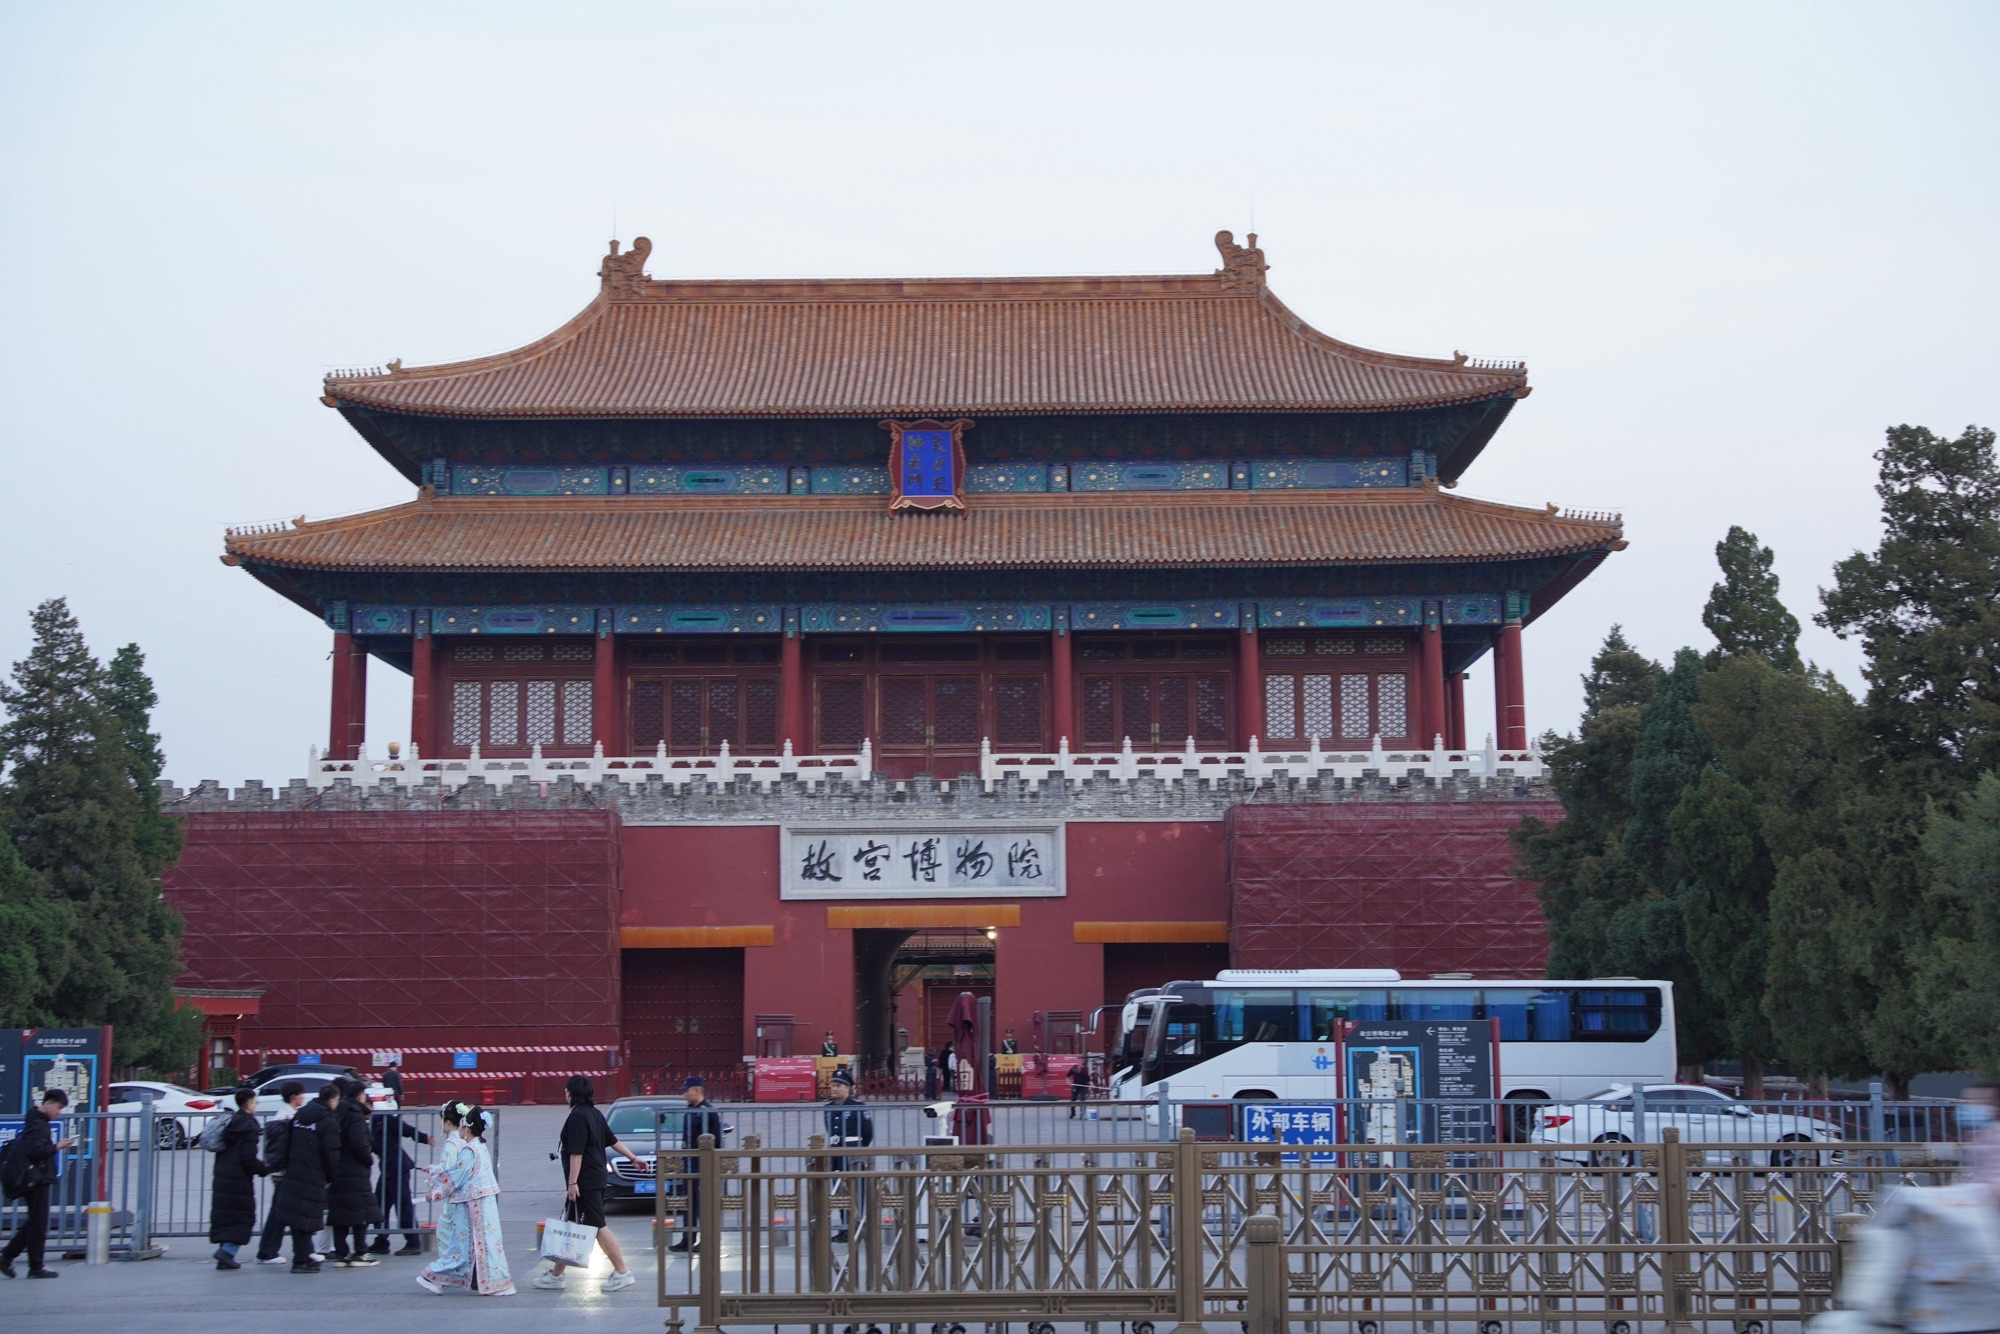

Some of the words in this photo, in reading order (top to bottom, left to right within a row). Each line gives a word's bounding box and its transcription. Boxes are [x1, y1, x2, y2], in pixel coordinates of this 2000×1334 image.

[801, 837, 1043, 883] 故宫博物院
[1251, 1111, 1331, 1132] 外部车辆
